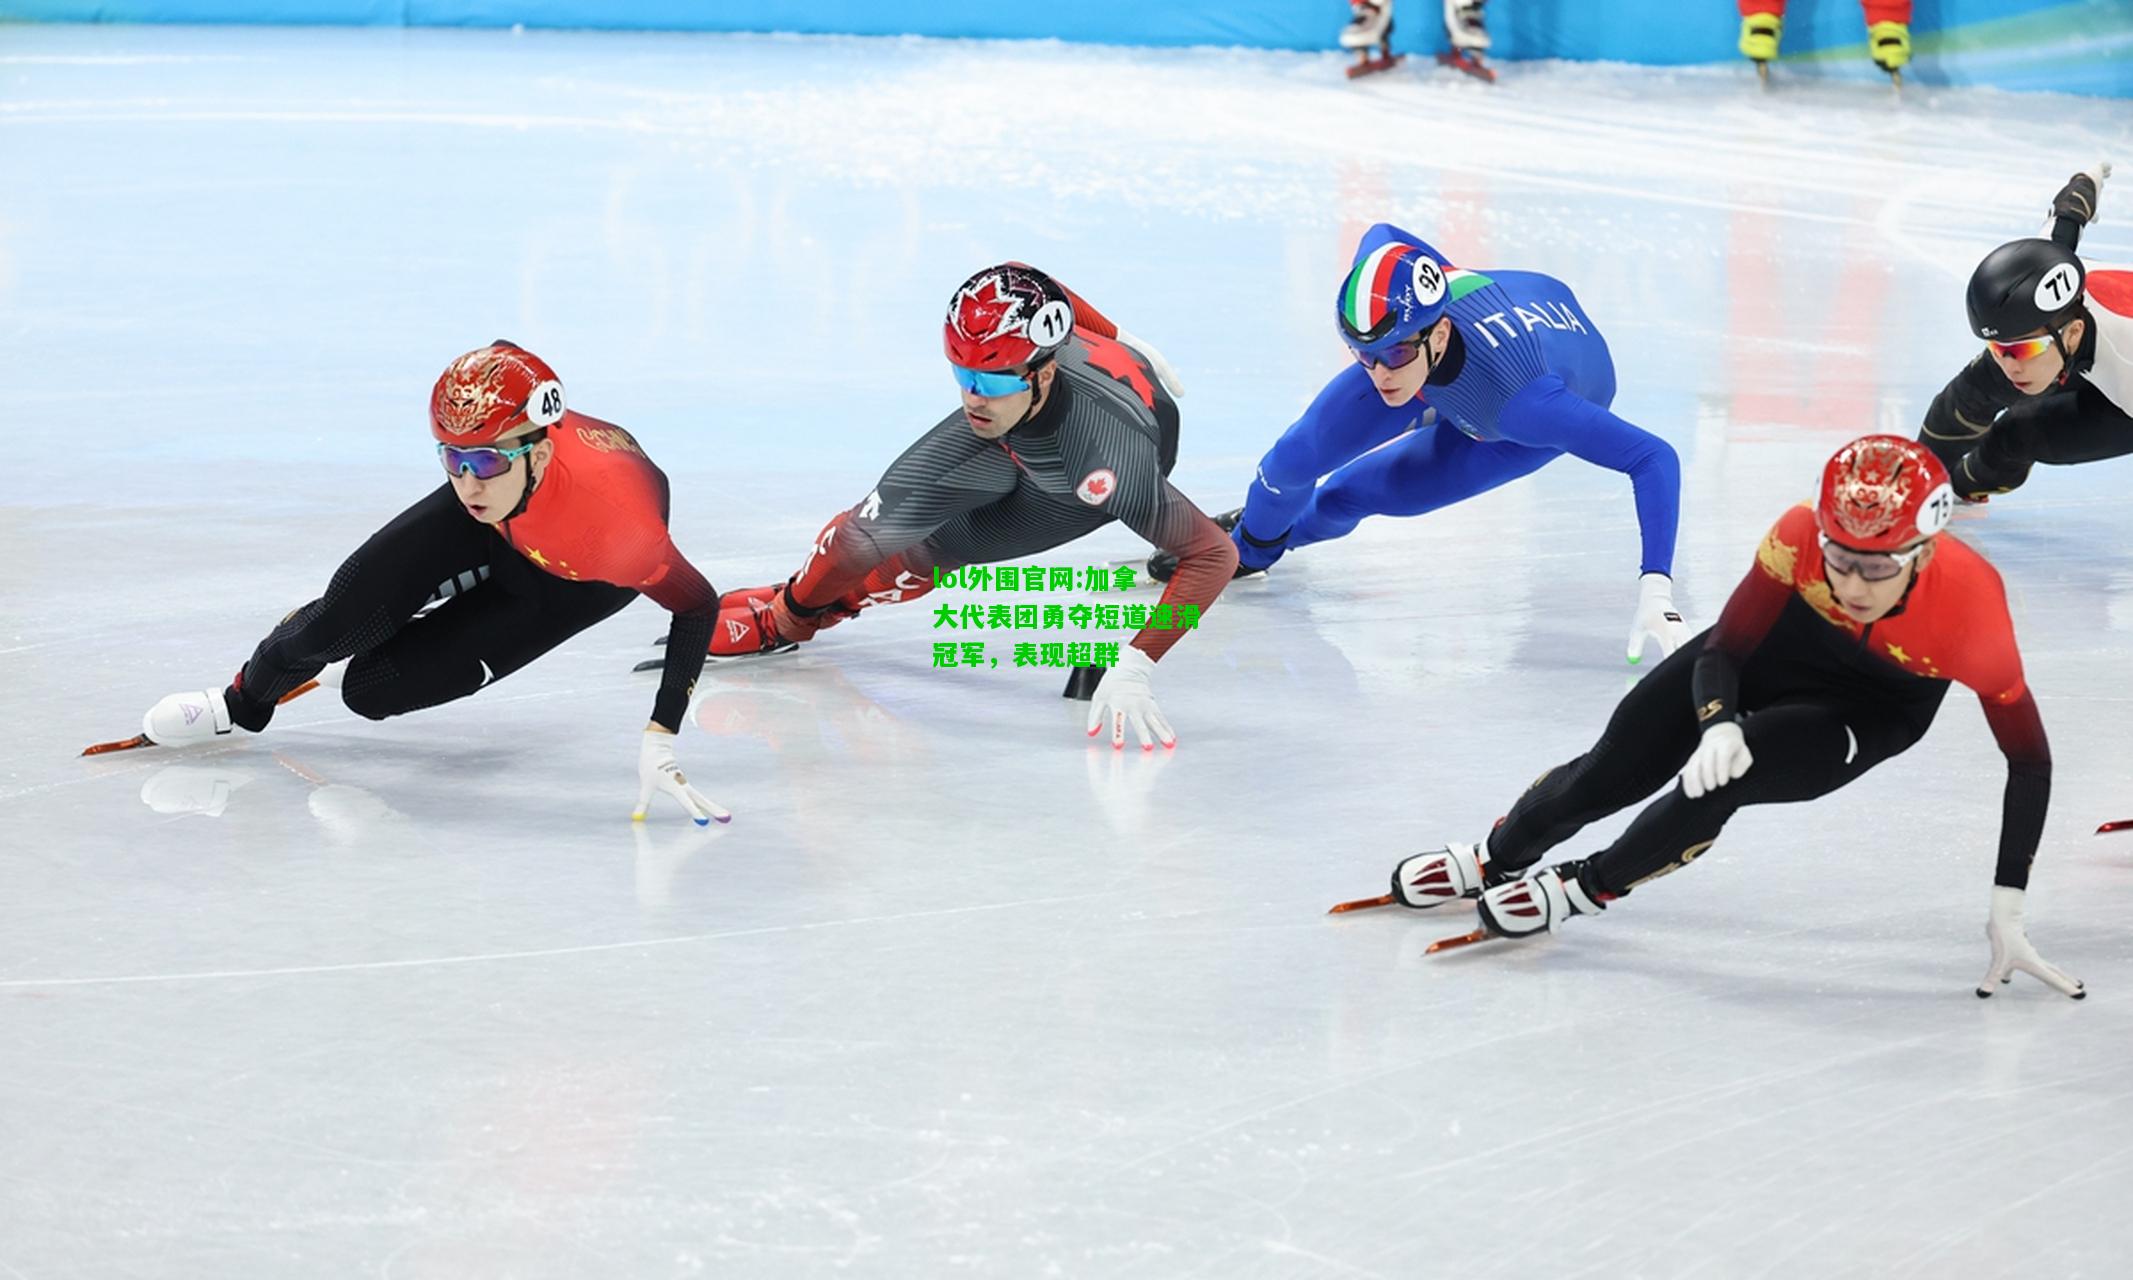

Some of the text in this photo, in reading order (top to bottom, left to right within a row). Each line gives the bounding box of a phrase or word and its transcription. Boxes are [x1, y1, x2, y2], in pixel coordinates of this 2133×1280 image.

[1418, 263, 1440, 291] 92
[2045, 268, 2072, 301] 77
[1043, 308, 1064, 338] 11
[1473, 301, 1588, 348] ITALIA
[541, 387, 562, 416] 48
